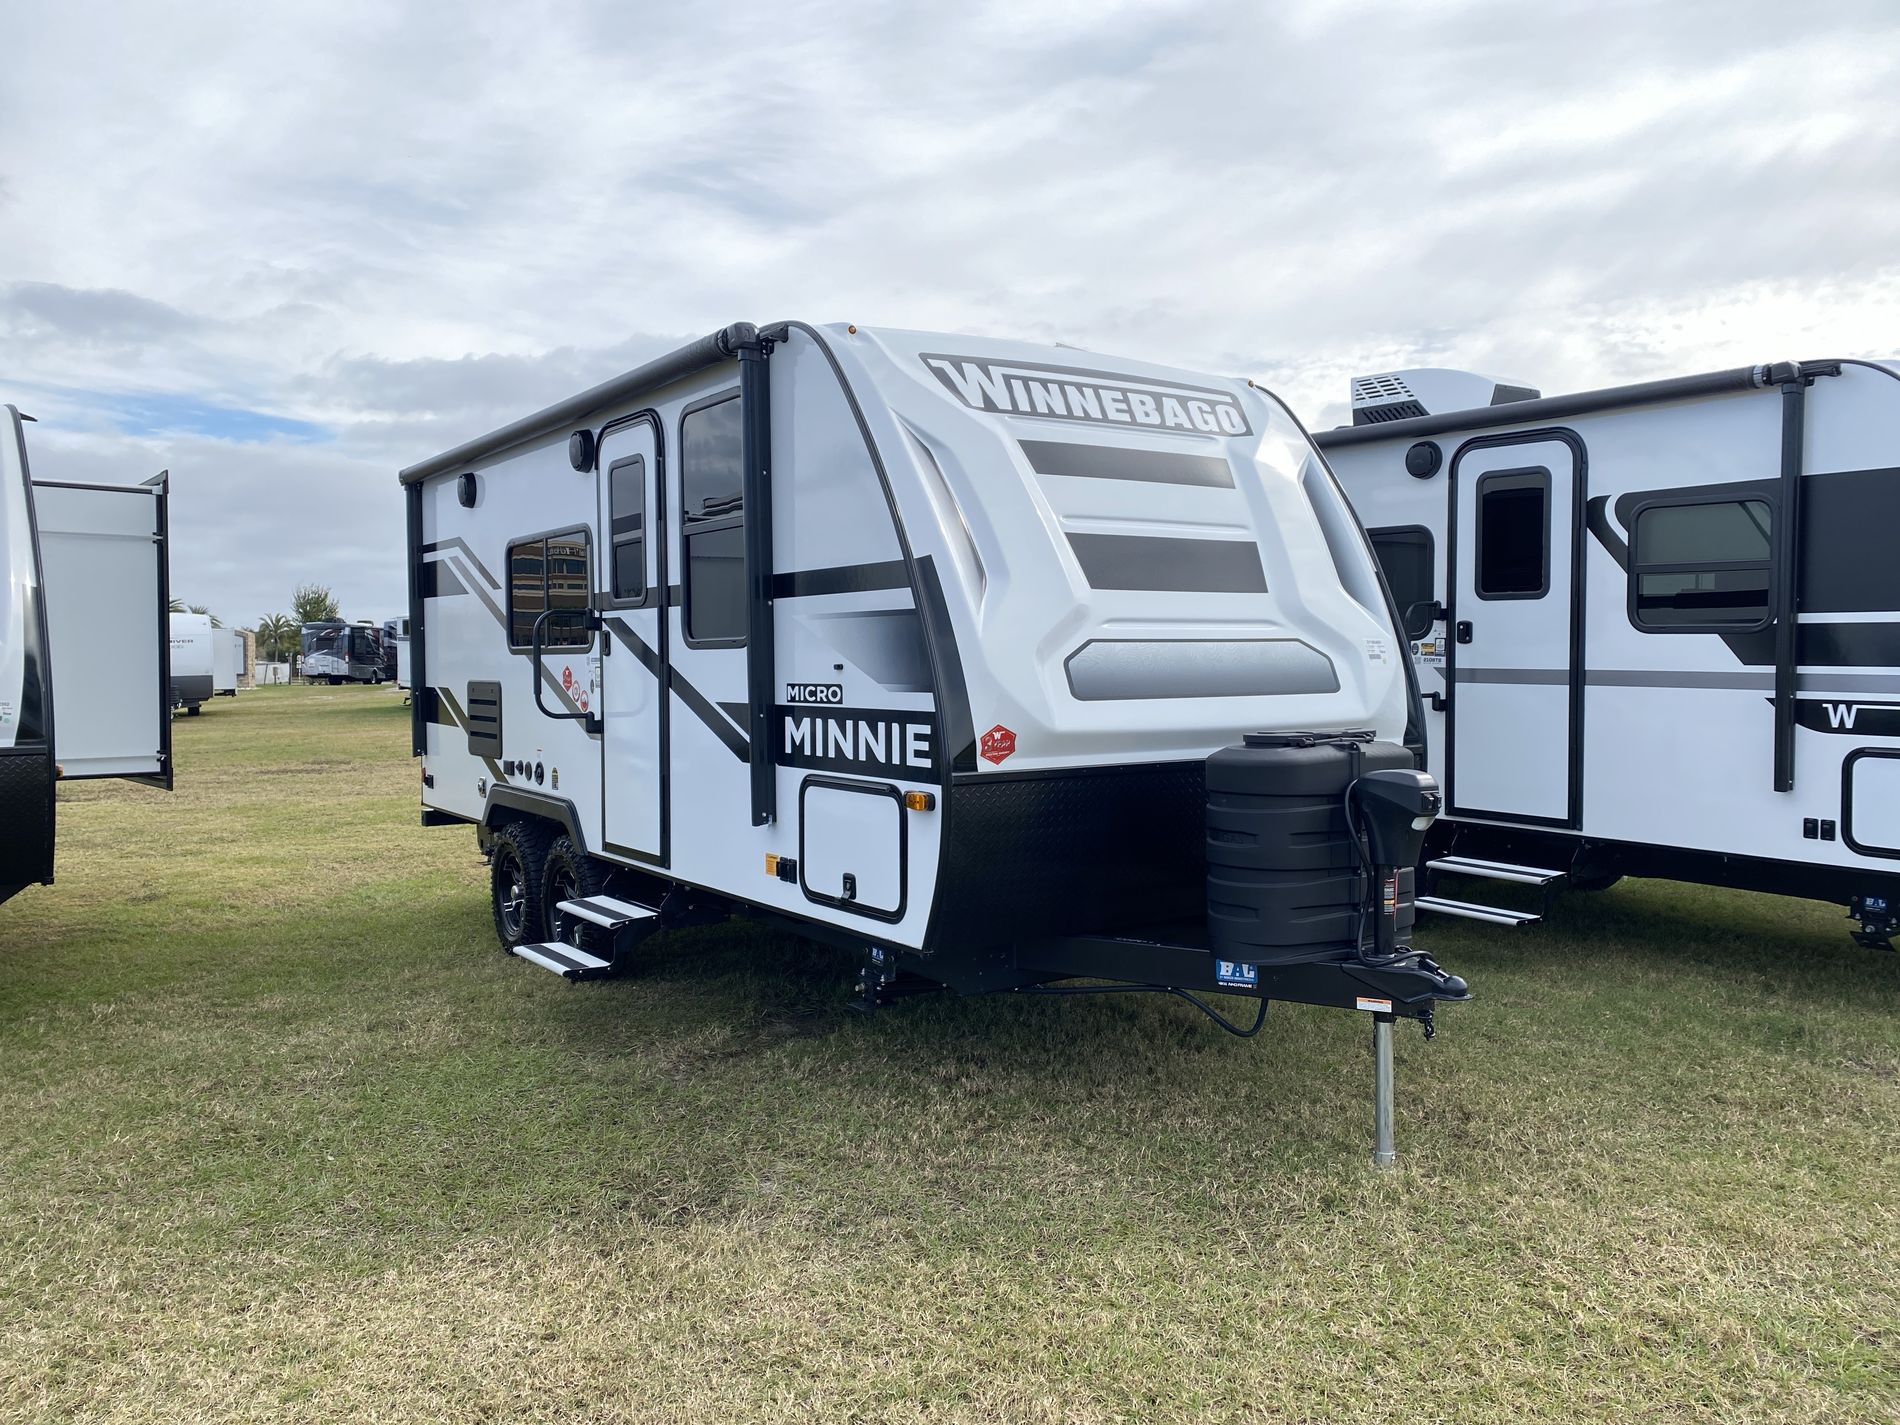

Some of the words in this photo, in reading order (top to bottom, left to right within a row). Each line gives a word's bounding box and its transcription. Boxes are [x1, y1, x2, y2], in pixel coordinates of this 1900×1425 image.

[927, 358, 1248, 435] WINNEBAGO
[787, 685, 842, 703] MICRO
[784, 716, 932, 769] MINNIE
